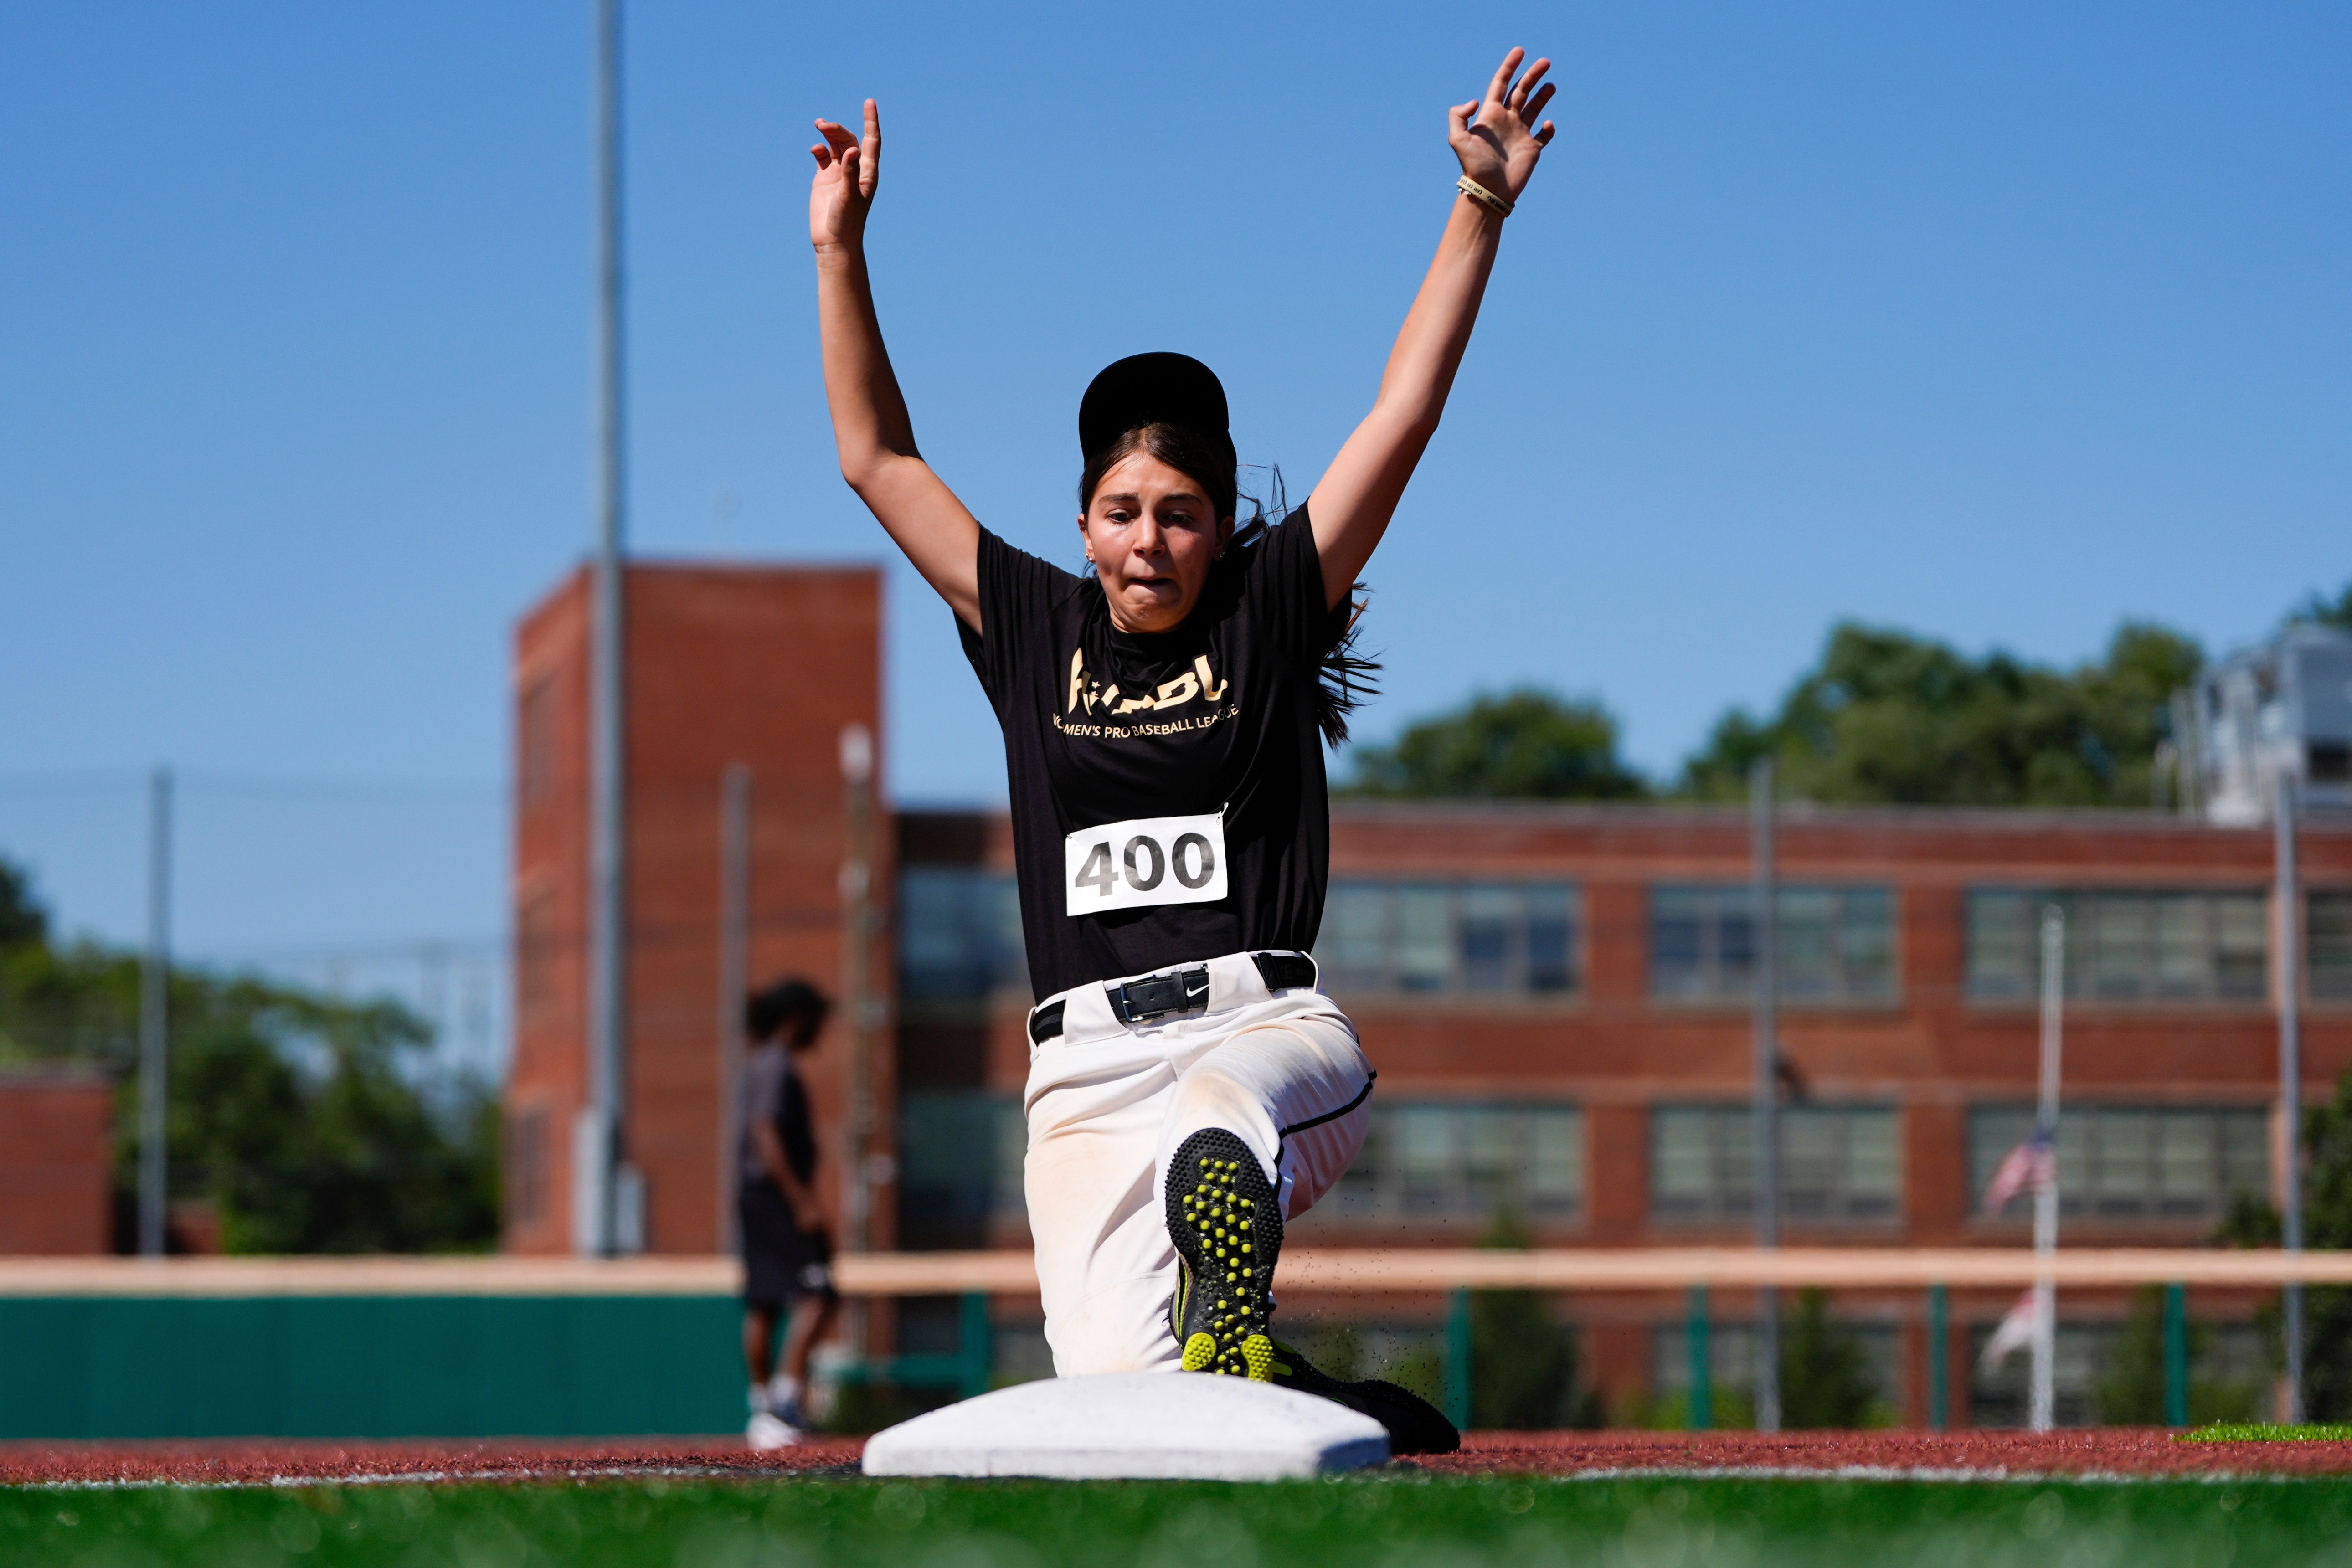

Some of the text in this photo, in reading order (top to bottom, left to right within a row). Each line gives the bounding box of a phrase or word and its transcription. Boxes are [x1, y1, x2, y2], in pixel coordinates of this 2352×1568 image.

[1104, 726, 1131, 738] PRO
[1131, 718, 1194, 737] BASEBALL
[1196, 703, 1239, 728] LEAGUE
[1075, 832, 1215, 897] 400
